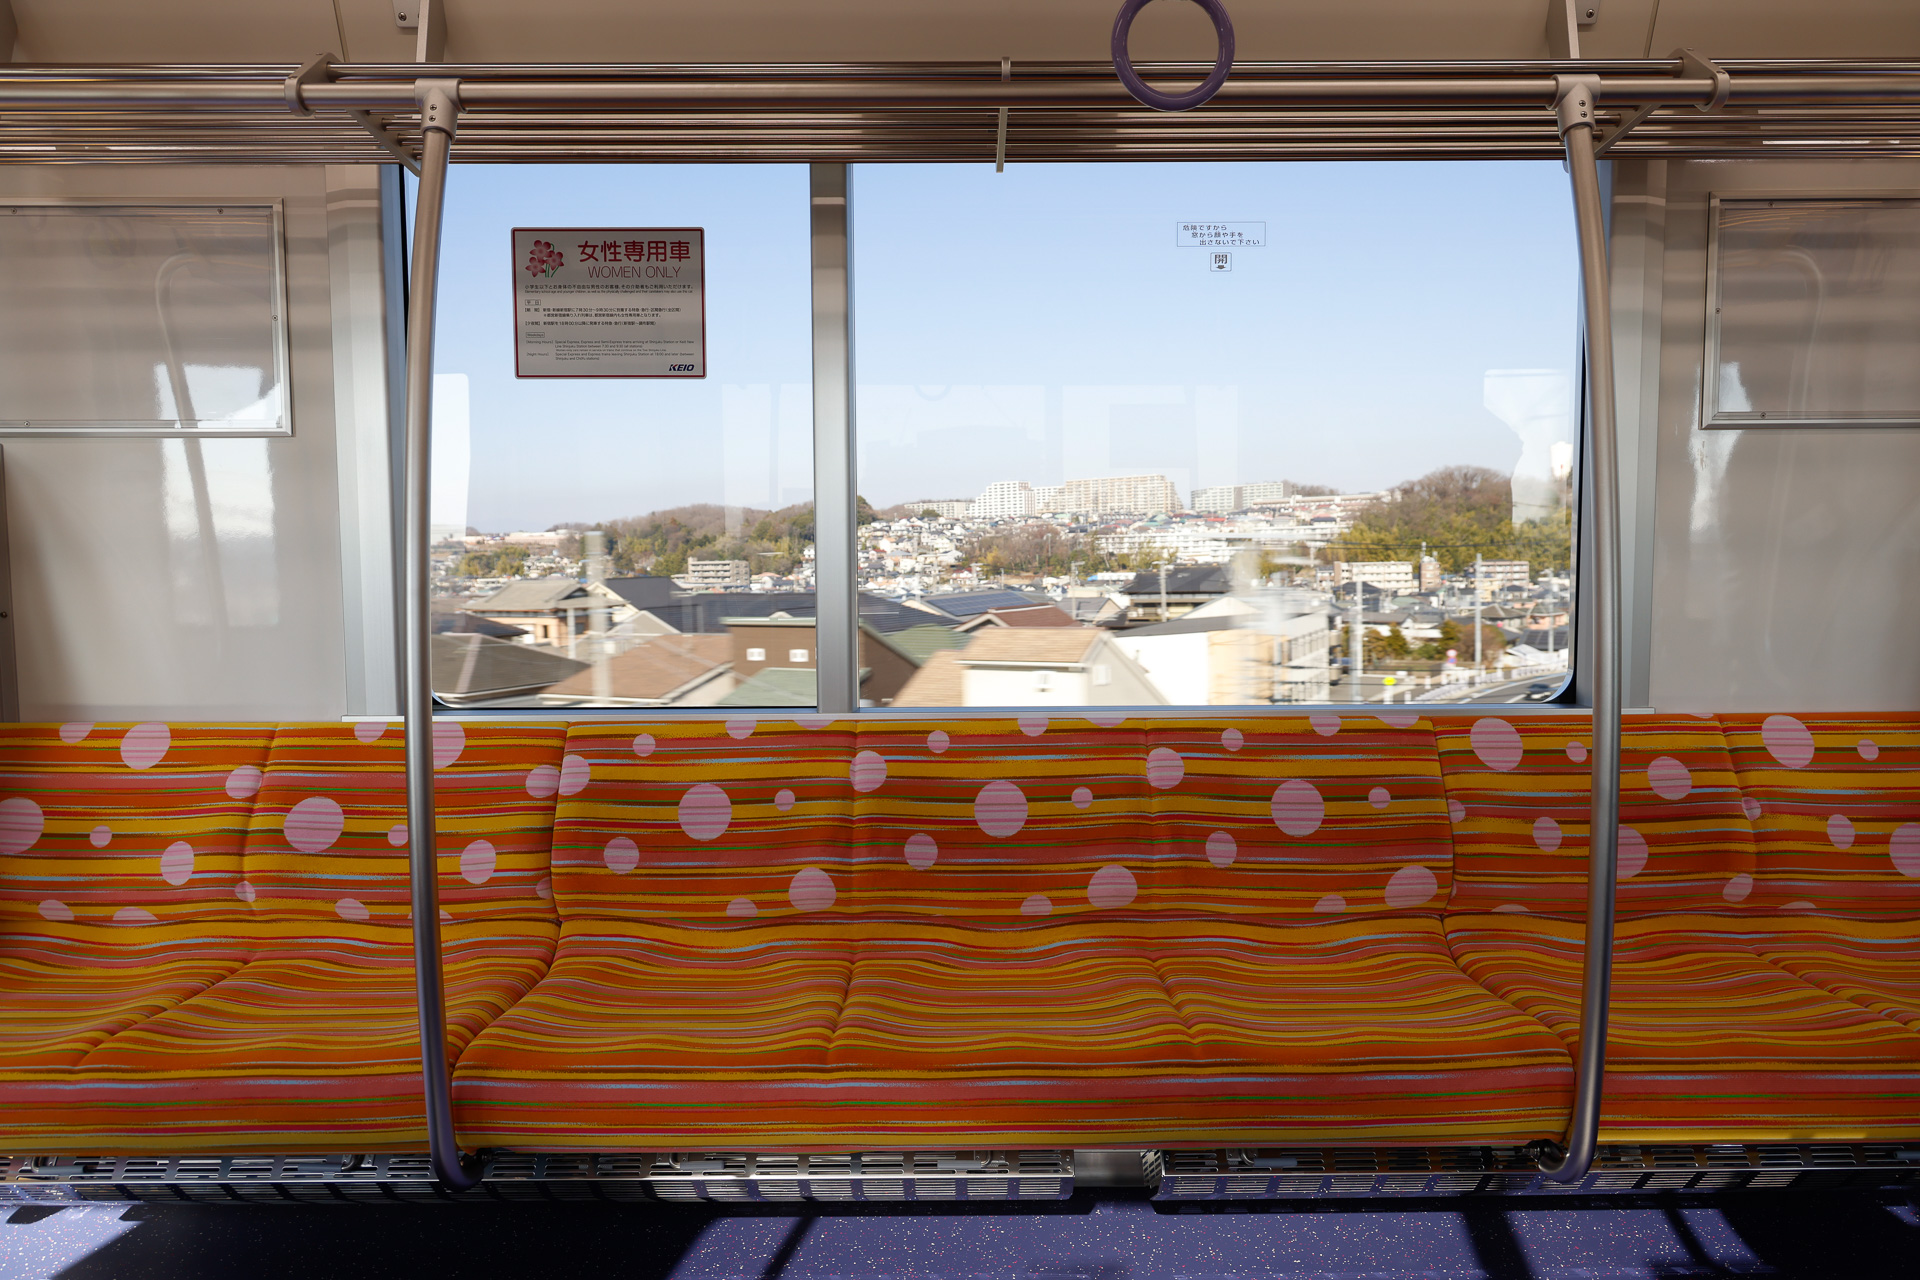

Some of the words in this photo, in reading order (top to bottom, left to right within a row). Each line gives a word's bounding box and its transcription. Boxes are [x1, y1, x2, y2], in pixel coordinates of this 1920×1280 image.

[577, 240, 691, 262] 女性専用車
[1214, 254, 1228, 264] 開
[587, 266, 641, 278] WOMEN
[645, 266, 682, 278] ONLY
